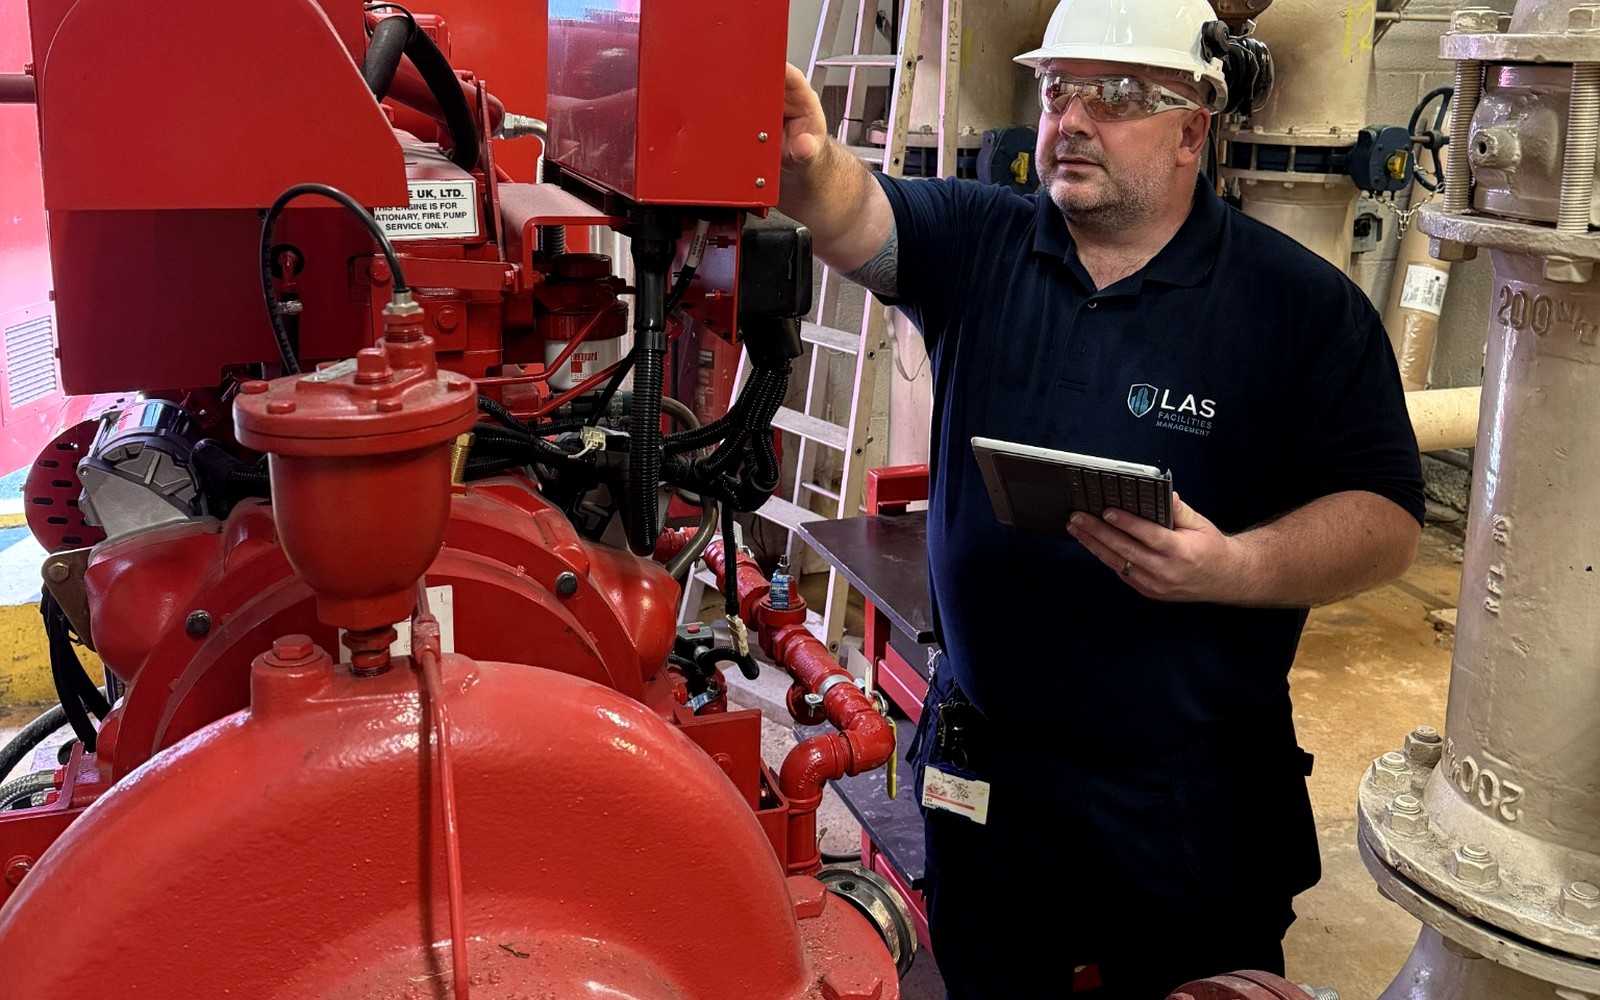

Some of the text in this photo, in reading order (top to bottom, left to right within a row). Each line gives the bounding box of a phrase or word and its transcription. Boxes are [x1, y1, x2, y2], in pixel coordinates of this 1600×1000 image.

[417, 189, 437, 199] UK,
[440, 189, 464, 198] LTD.
[440, 202, 457, 210] FOR
[375, 211, 467, 221] ATIONARY, FIRE PUMP
[385, 221, 449, 231] SERVICE ONLY.
[1498, 284, 1553, 337] 200
[1160, 389, 1216, 418] LAS
[1156, 420, 1210, 436] MANAGEMENT
[1158, 411, 1212, 429] FACILITIES
[1460, 755, 1525, 821] 200
